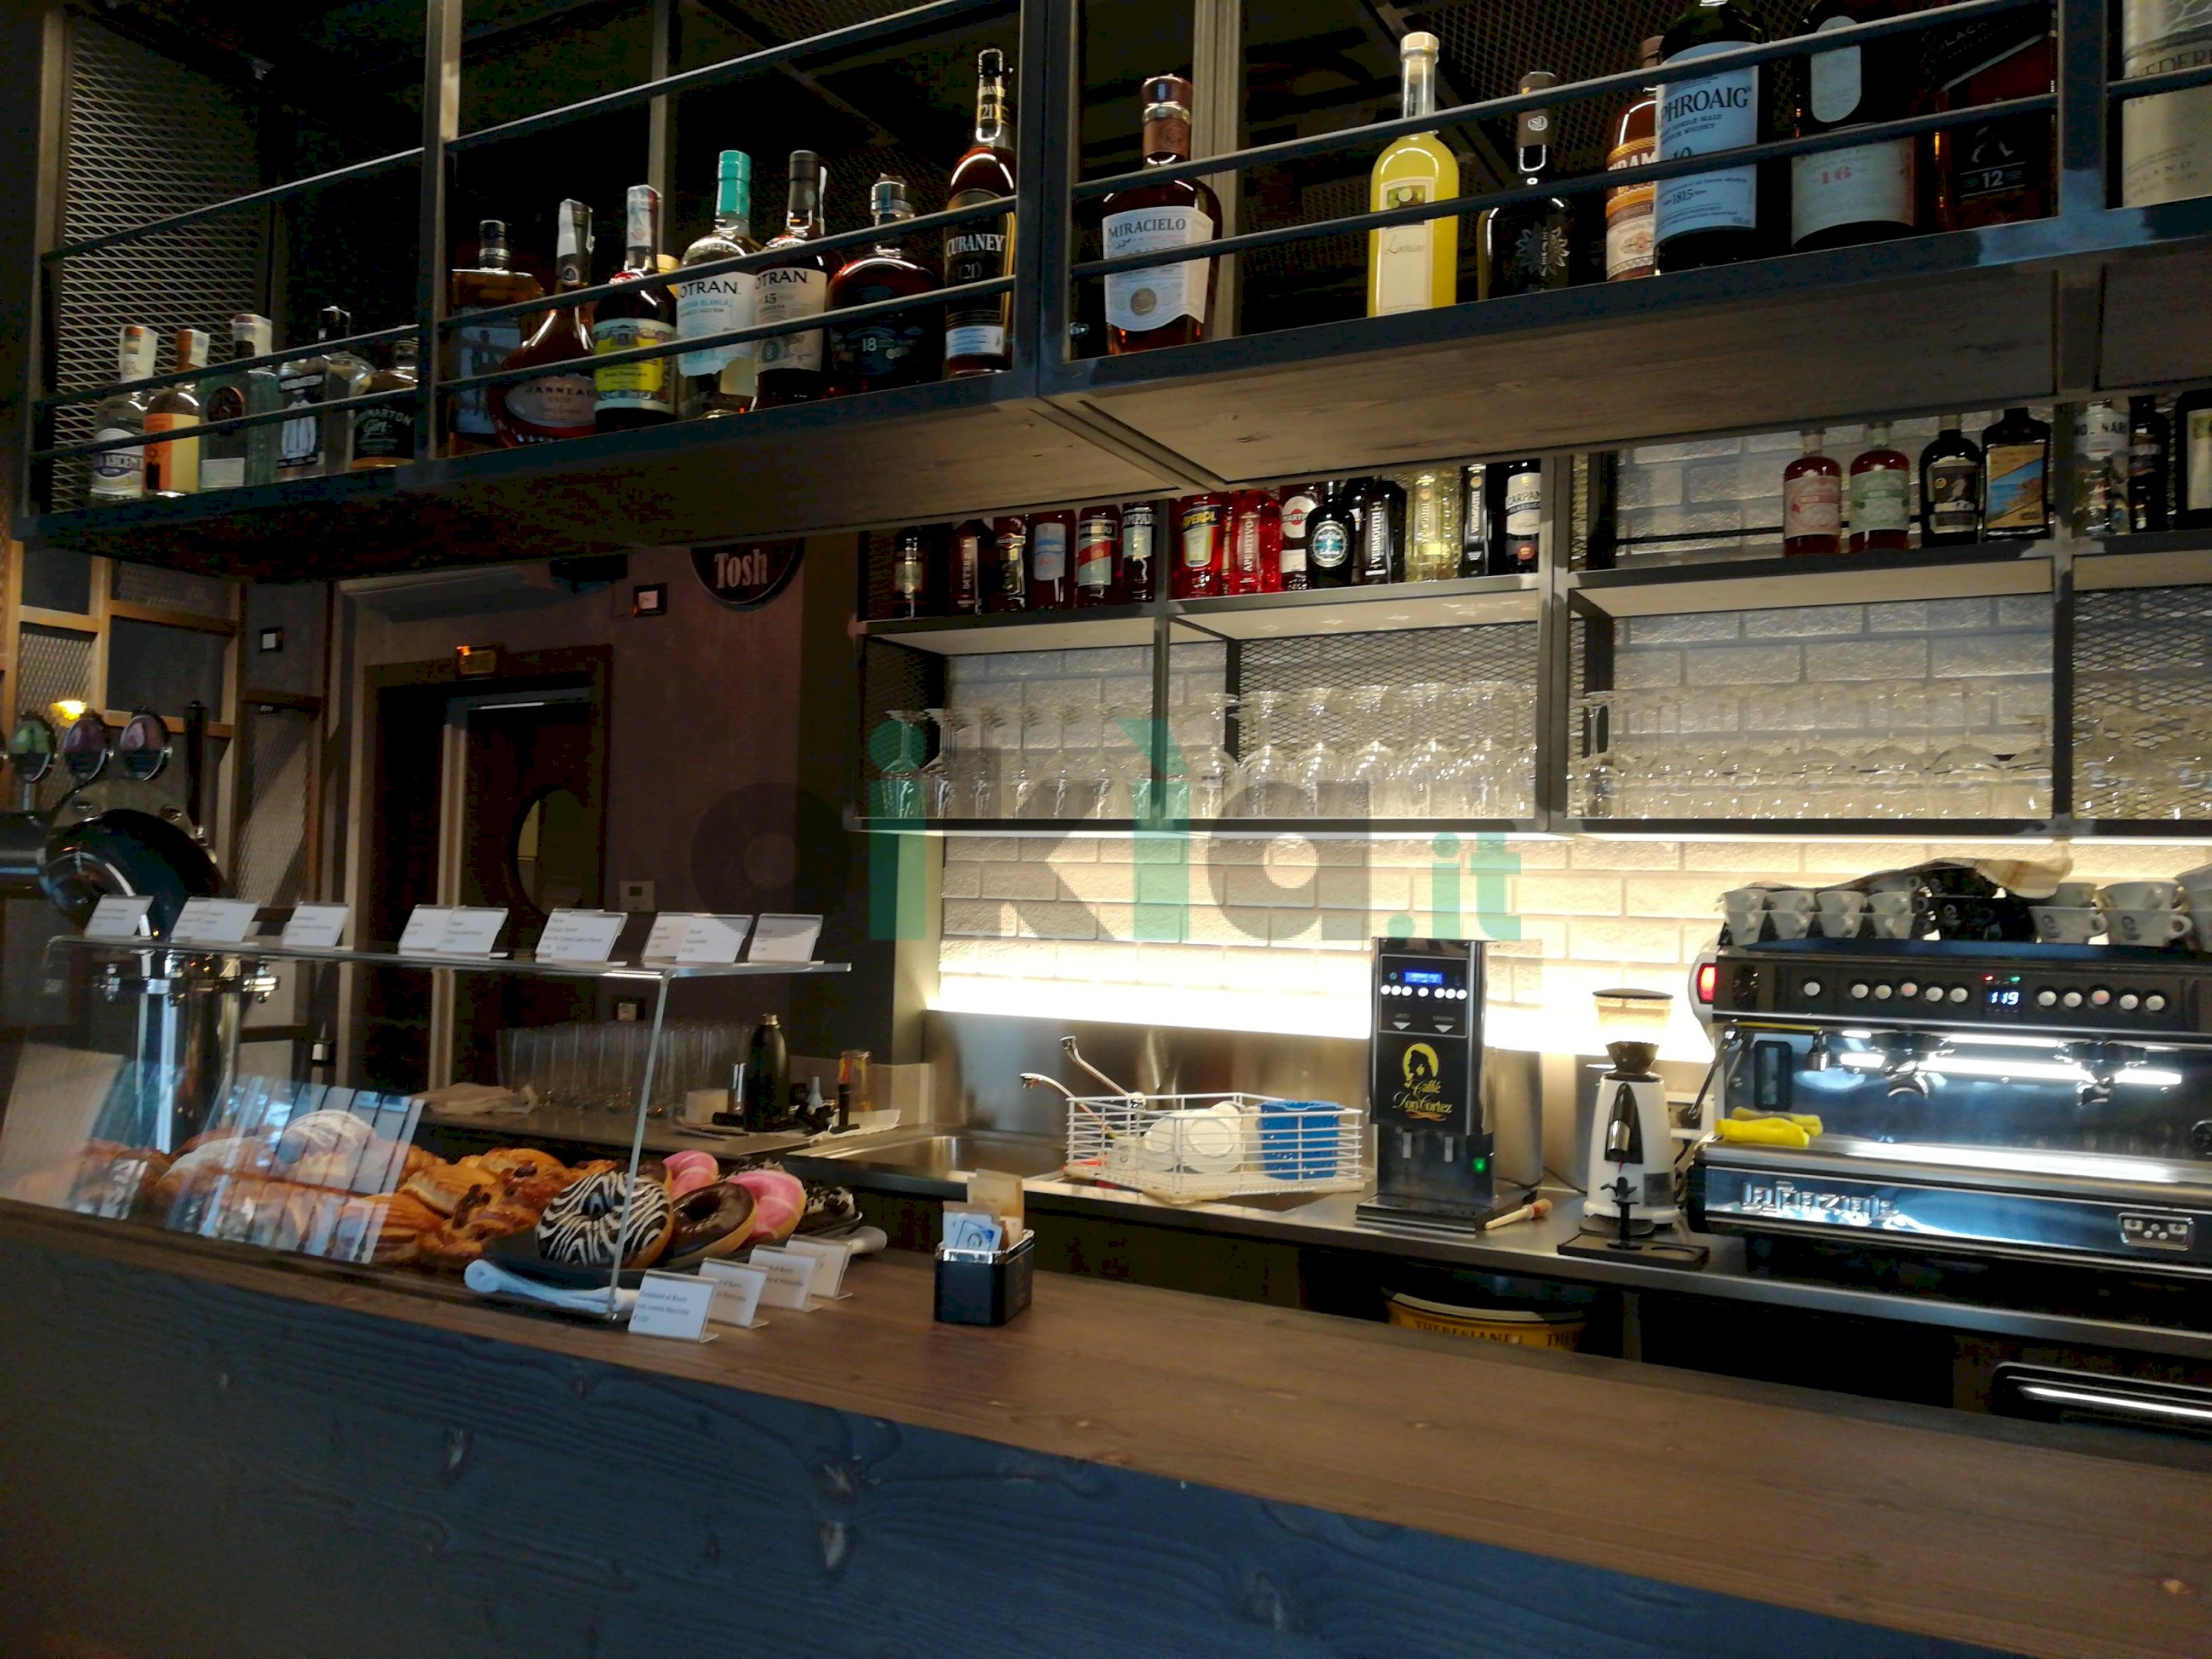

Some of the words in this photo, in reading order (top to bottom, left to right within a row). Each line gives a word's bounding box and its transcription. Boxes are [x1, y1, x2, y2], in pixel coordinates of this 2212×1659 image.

[1659, 87, 1749, 127] PHROAIG
[1982, 170, 2005, 188] 12
[1108, 217, 1187, 237] MIRACIELO
[946, 233, 1006, 257] CUBANEY
[862, 337, 878, 353] 18
[1243, 518, 1255, 572] APERITIVO
[1371, 510, 1382, 565] VERMOUTH
